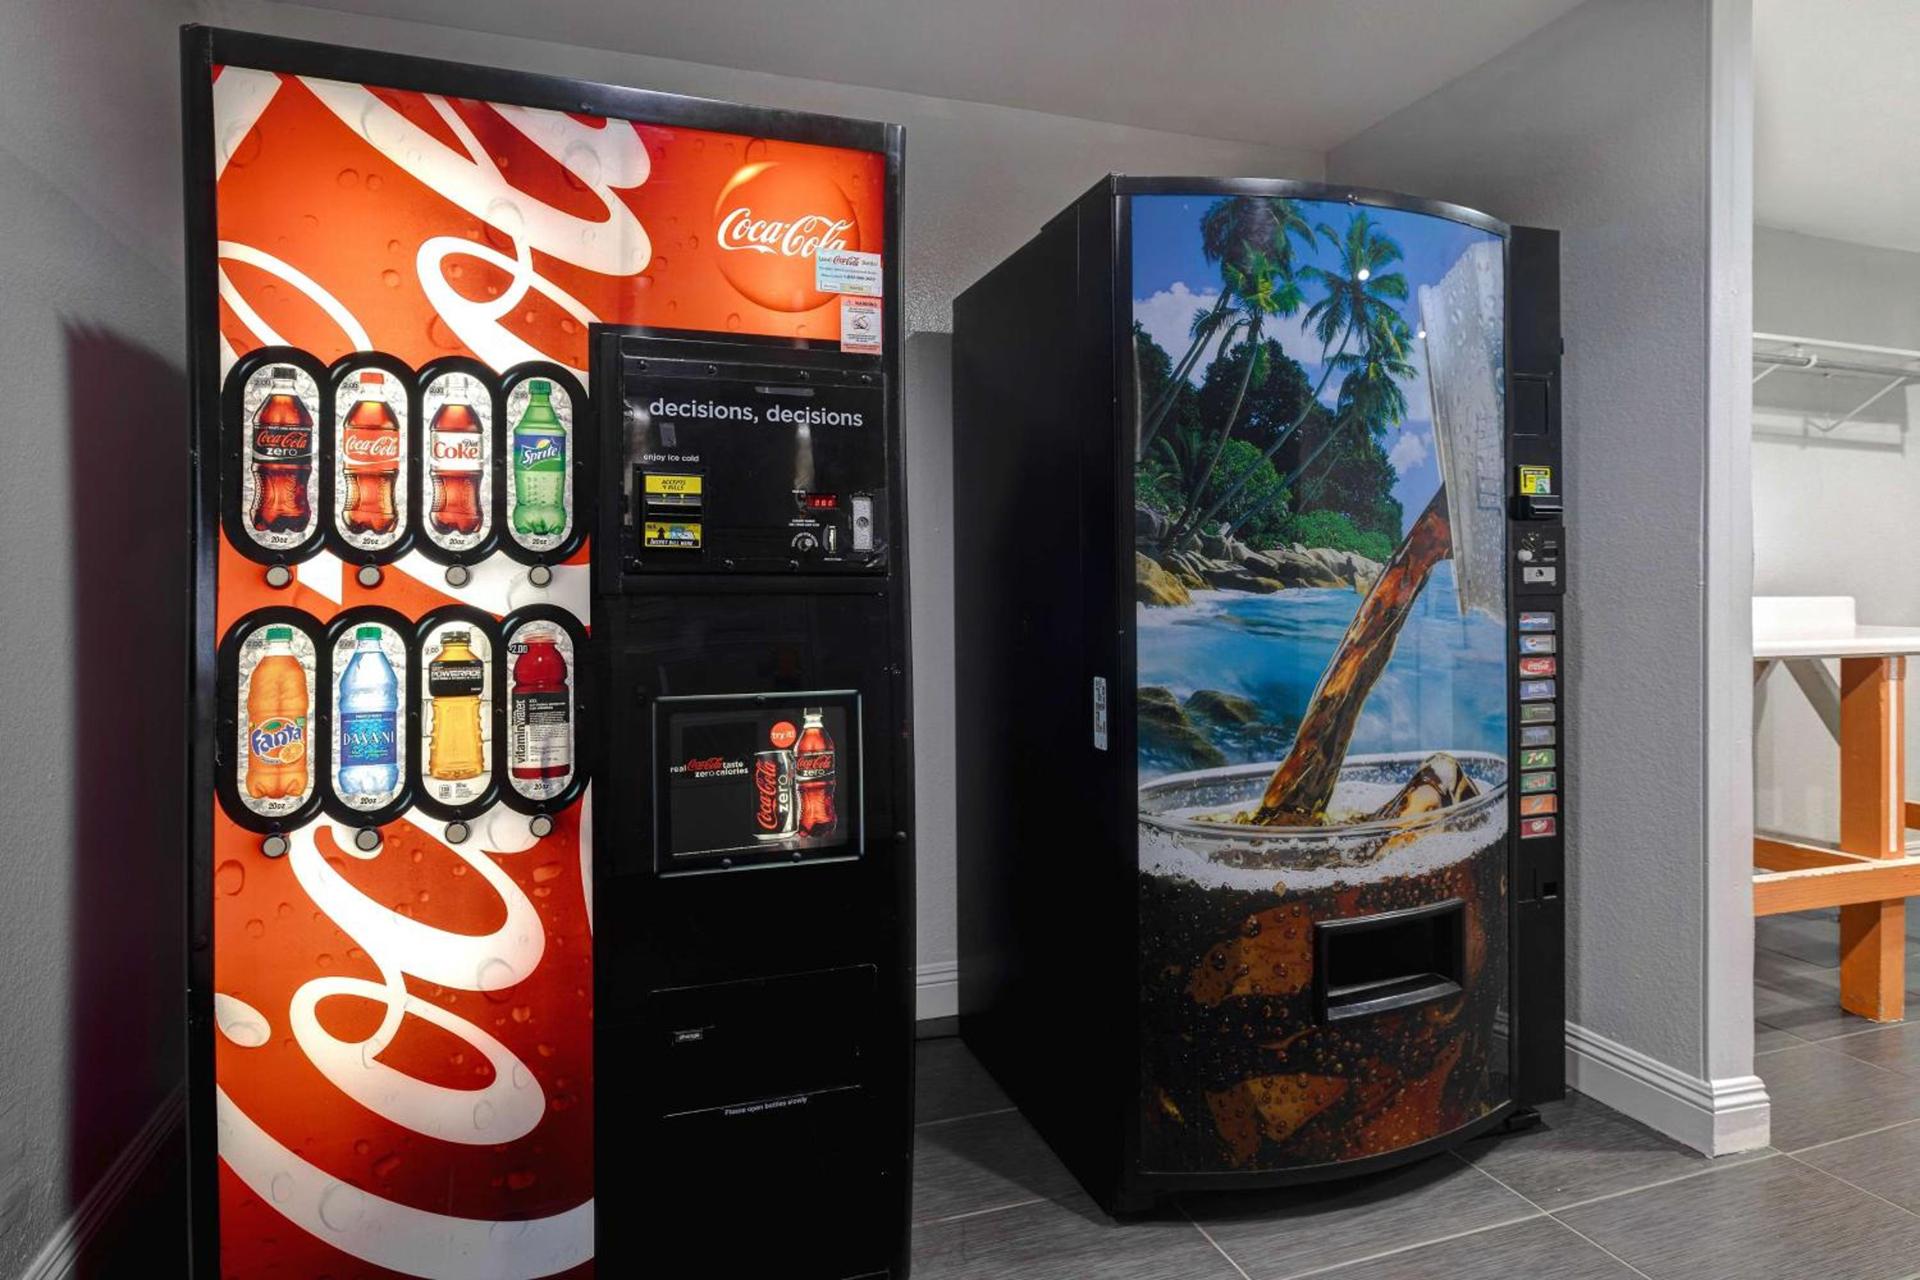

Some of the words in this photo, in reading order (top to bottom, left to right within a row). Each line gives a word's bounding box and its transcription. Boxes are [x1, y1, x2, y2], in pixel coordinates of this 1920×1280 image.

[649, 397, 759, 424] decisions,
[766, 404, 864, 427] decisions
[256, 430, 308, 448] Coca-Cola
[345, 434, 398, 456] Coca-Cola
[266, 447, 298, 456] zero
[433, 441, 479, 459] Coke
[521, 445, 558, 465] Sprite
[643, 453, 666, 462] enjoy
[667, 453, 681, 462] ice
[251, 722, 302, 757] Fanta
[343, 731, 394, 746] DASANI
[514, 700, 526, 764] vitaminwater
[670, 764, 687, 773] real
[797, 755, 832, 770] Coca-Cola
[695, 770, 715, 778] zero
[715, 767, 749, 776] calories
[803, 769, 826, 777] zero
[756, 760, 778, 830] Coca-Cola
[778, 774, 789, 813] zero
